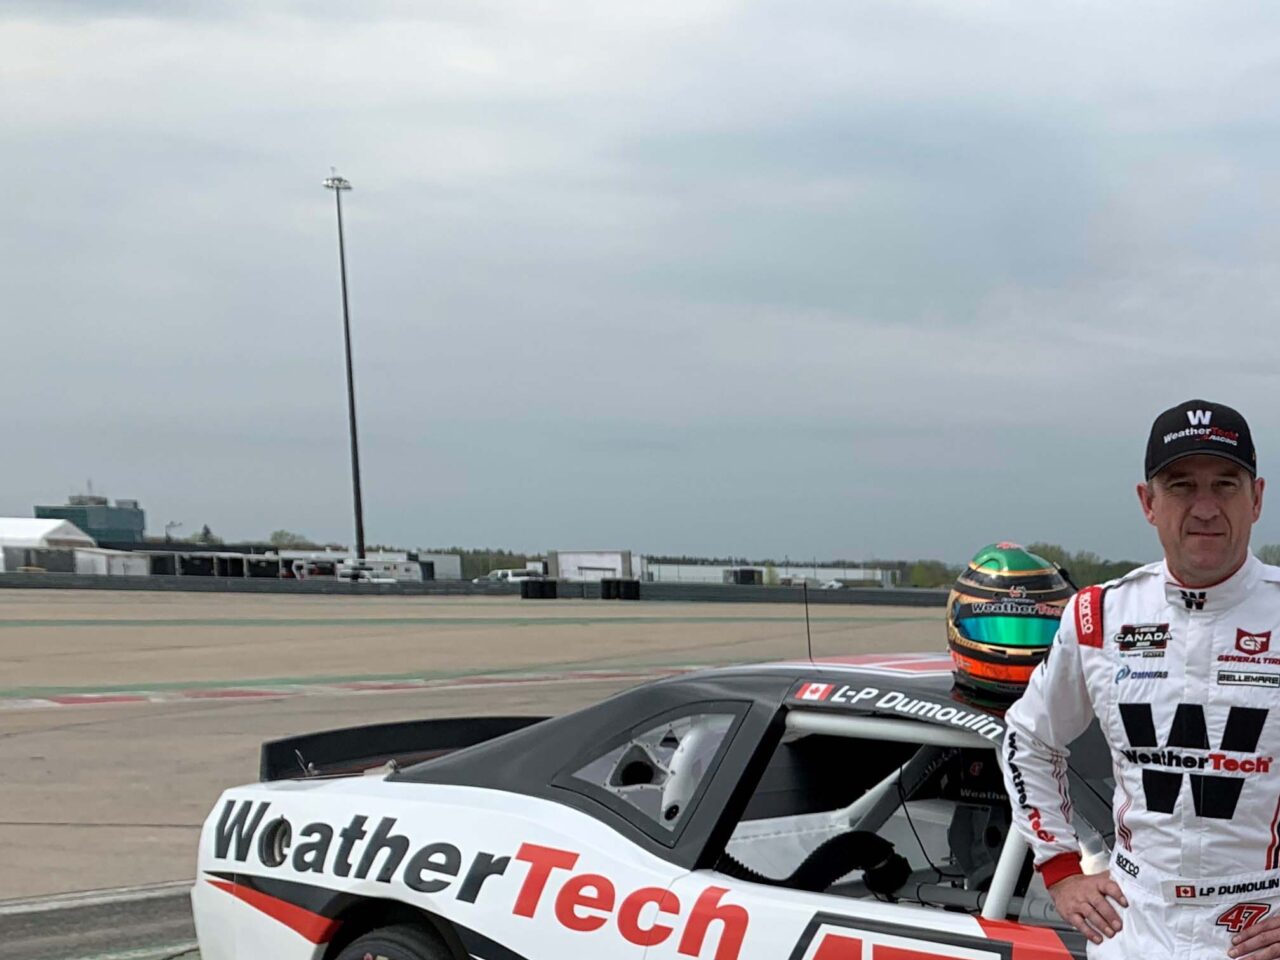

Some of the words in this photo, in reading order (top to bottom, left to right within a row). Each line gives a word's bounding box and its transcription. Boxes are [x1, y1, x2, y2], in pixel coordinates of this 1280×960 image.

[1186, 410, 1212, 425] W
[1163, 426, 1238, 444] WeatherTech
[1113, 631, 1172, 643] CANADA
[1217, 655, 1261, 664] GENERAL
[1218, 674, 1279, 684] BELLEMARE
[829, 685, 873, 703] L-P
[875, 691, 1005, 740] Dumoulin
[1121, 750, 1270, 773] WeatherTech
[960, 788, 1010, 800] Weathe
[1115, 853, 1139, 878] sparco
[1199, 887, 1215, 896] LP
[1218, 879, 1279, 895] DUMOULIN
[1216, 902, 1271, 932] 47
